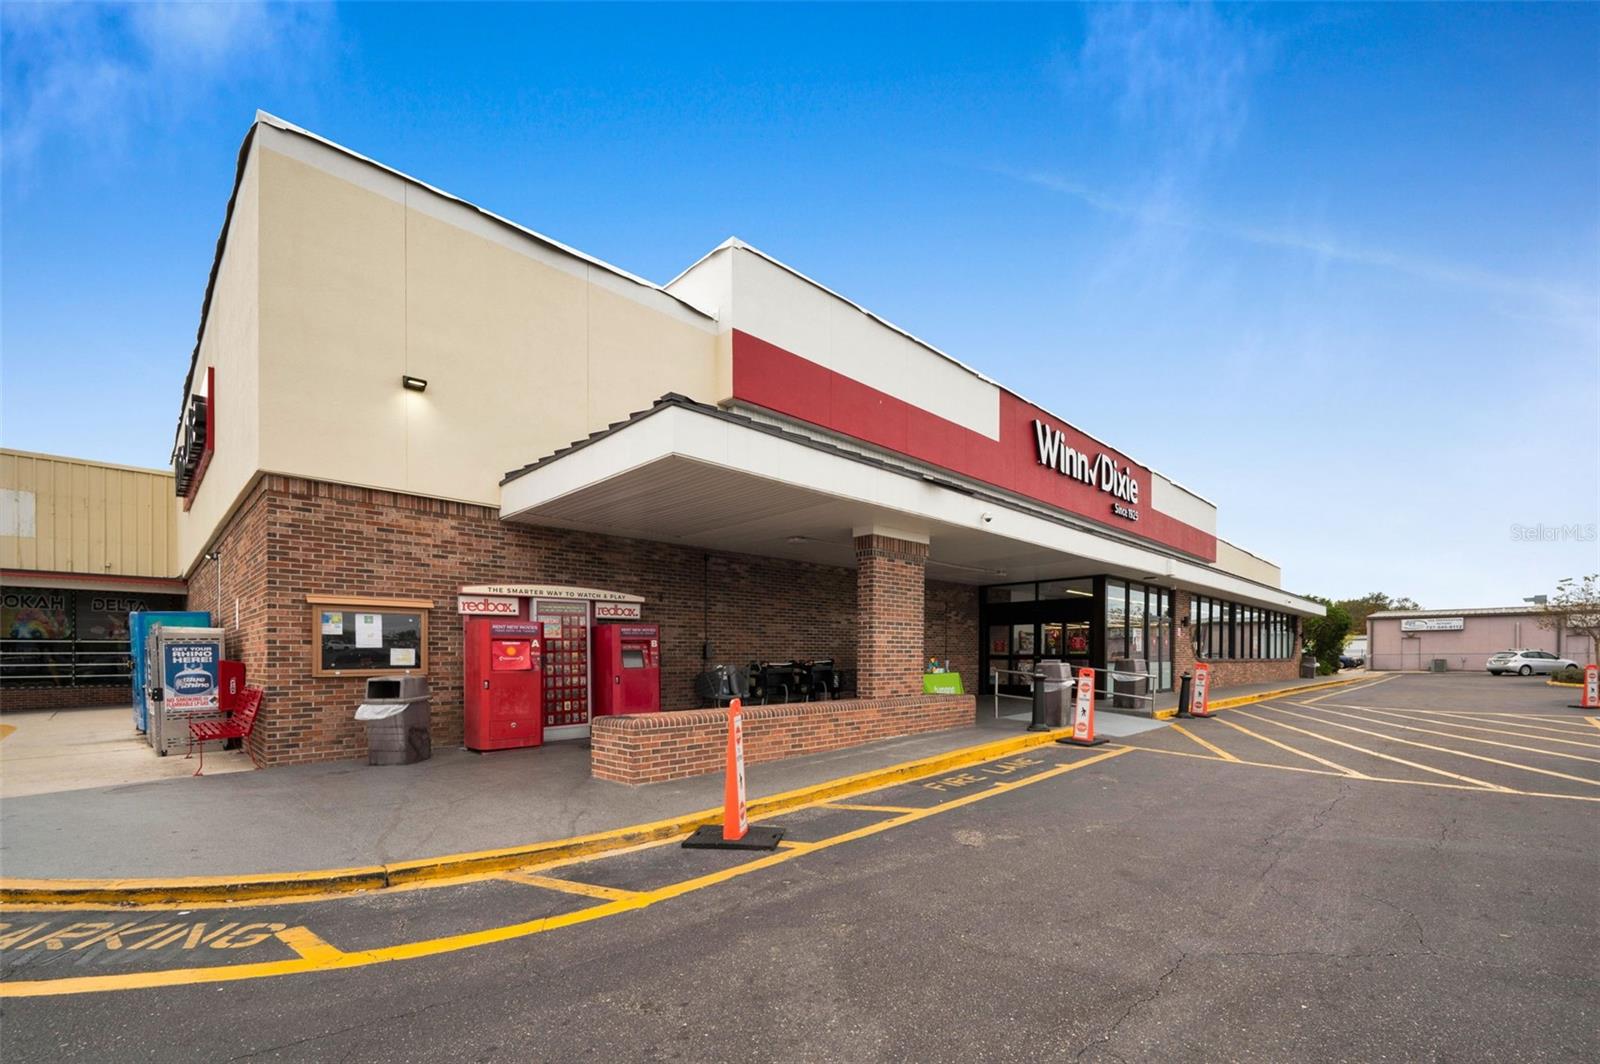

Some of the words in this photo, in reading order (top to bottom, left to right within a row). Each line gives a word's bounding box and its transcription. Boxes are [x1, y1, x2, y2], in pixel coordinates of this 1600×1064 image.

[1035, 419, 1089, 484] Winn
[1101, 454, 1139, 504] Dixie
[1115, 503, 1128, 518] Since
[507, 587, 544, 595] SMARTER
[91, 598, 149, 612] DELTA
[531, 640, 540, 648] A
[0, 922, 287, 950] ARKING
